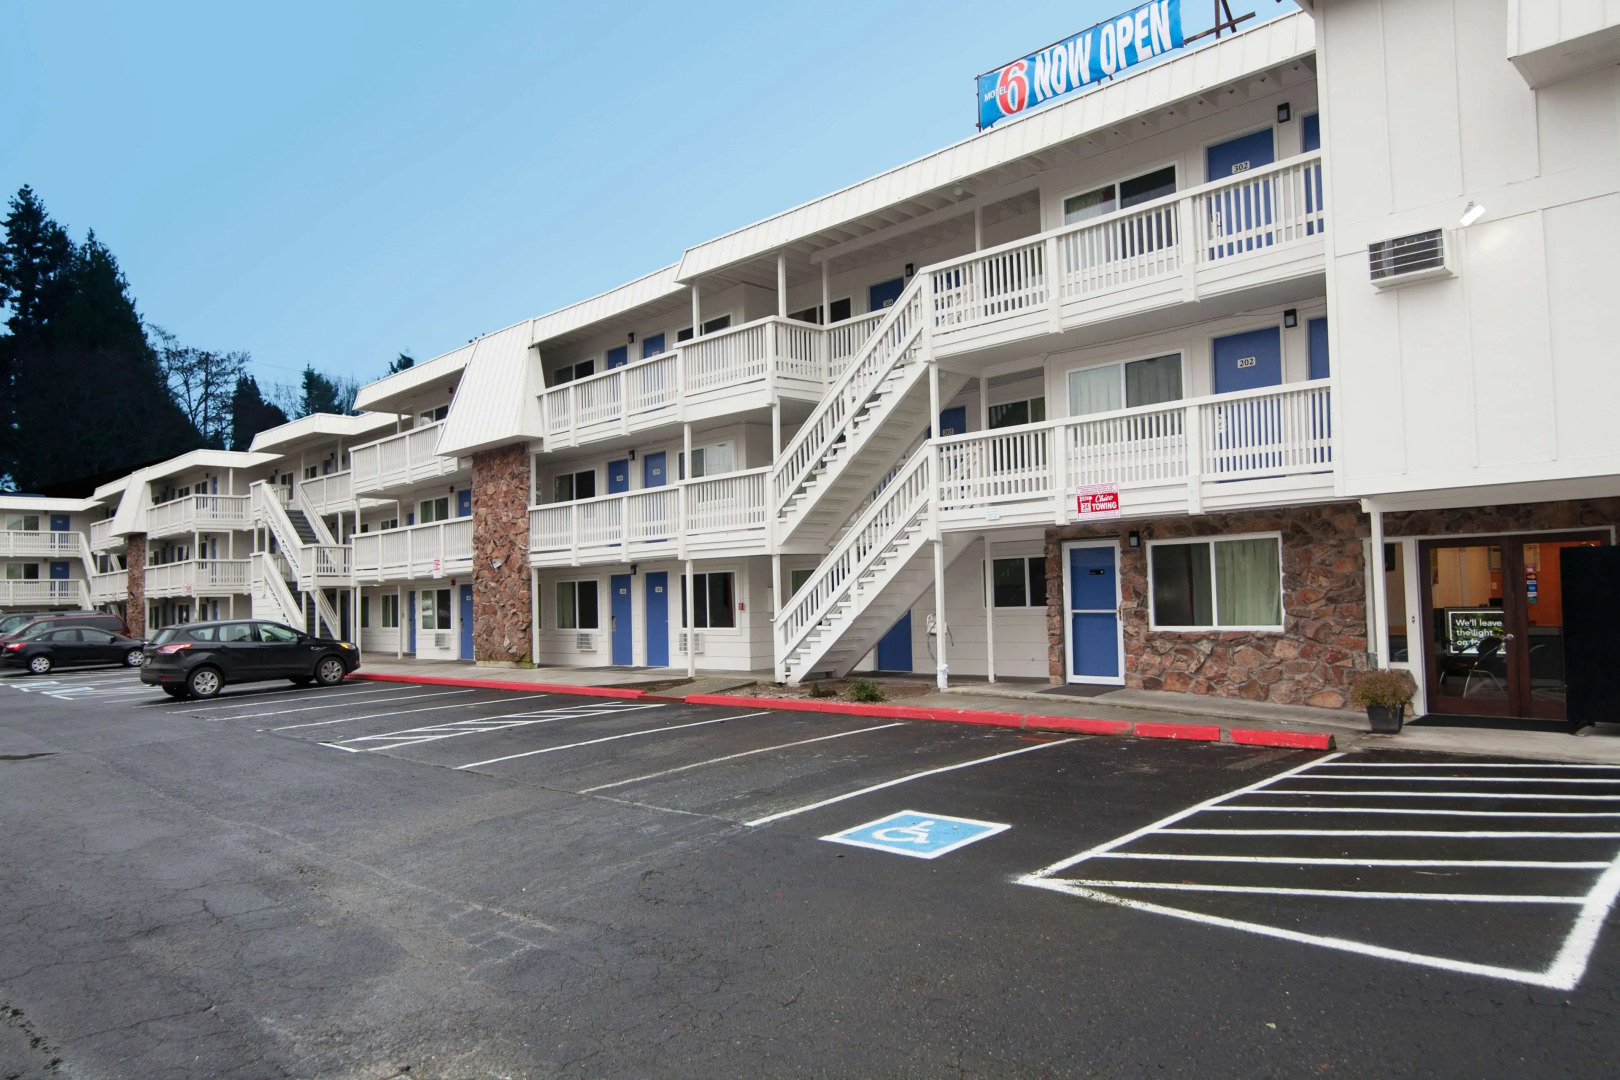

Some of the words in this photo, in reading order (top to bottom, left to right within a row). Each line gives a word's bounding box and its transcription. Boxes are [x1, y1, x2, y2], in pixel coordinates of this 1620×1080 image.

[984, 85, 1008, 102] MOTEL
[998, 60, 1027, 115] 6
[1034, 32, 1092, 102] NOW
[1100, 0, 1173, 75] OPEN
[1233, 162, 1248, 172] 302
[1240, 358, 1254, 366] 202
[1092, 502, 1117, 511] TOWING
[1473, 629, 1494, 638] light
